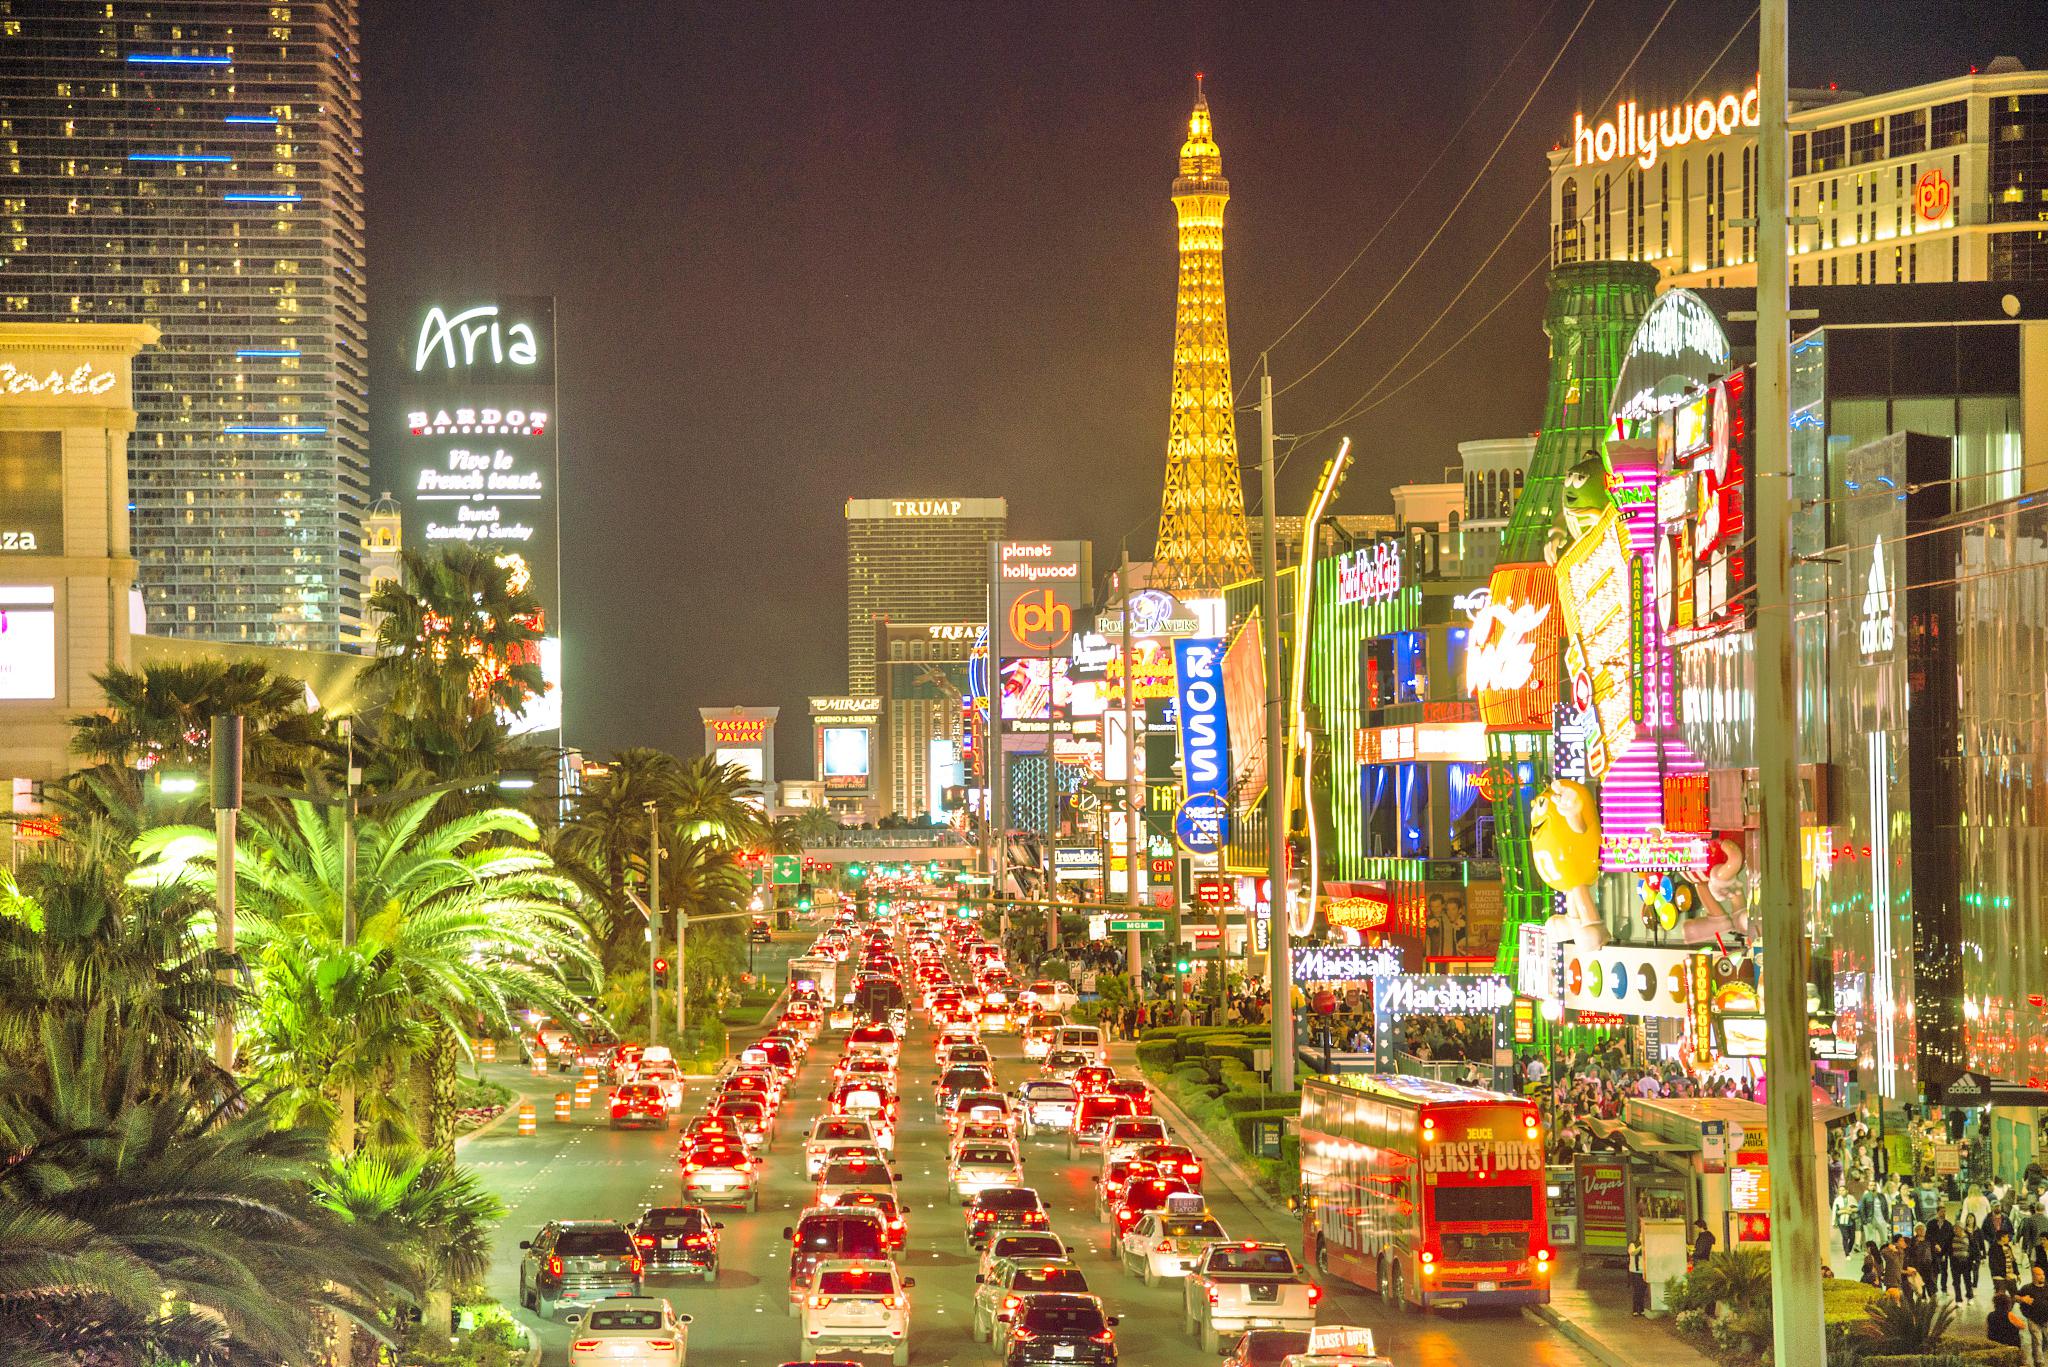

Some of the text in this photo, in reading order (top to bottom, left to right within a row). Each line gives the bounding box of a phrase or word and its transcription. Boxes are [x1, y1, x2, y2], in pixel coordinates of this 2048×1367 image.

[415, 306, 537, 372] Aria
[407, 409, 547, 428] BARDOT
[449, 450, 513, 470] Vive le
[417, 470, 484, 490] French
[457, 505, 500, 521] Brunch
[892, 501, 962, 517] TRUMP
[0, 532, 37, 550] za
[425, 523, 477, 541] Saturday
[488, 523, 533, 541] Sunday
[1003, 542, 1052, 561] planet
[1003, 563, 1077, 581] hollywood
[1018, 589, 1071, 641] ph
[1632, 559, 1642, 663] MARGARITAS
[1144, 617, 1199, 632] TOWERS
[822, 698, 881, 712] MIRAGE
[814, 715, 842, 724] CASINO
[849, 715, 878, 724] RESORT
[1187, 647, 1219, 783] ROSS
[713, 721, 766, 732] CAESARS
[716, 731, 764, 742] PALACE
[1126, 922, 1149, 930] MGM
[1295, 950, 1401, 979] Marshalls
[1696, 955, 1710, 1060] FOOD COURT
[1947, 1085, 1982, 1094] adidas
[1423, 1140, 1541, 1172] JERSEY BOYS
[1582, 1174, 1625, 1197] Vegas
[1315, 1330, 1369, 1349] JERSEY BOYS
